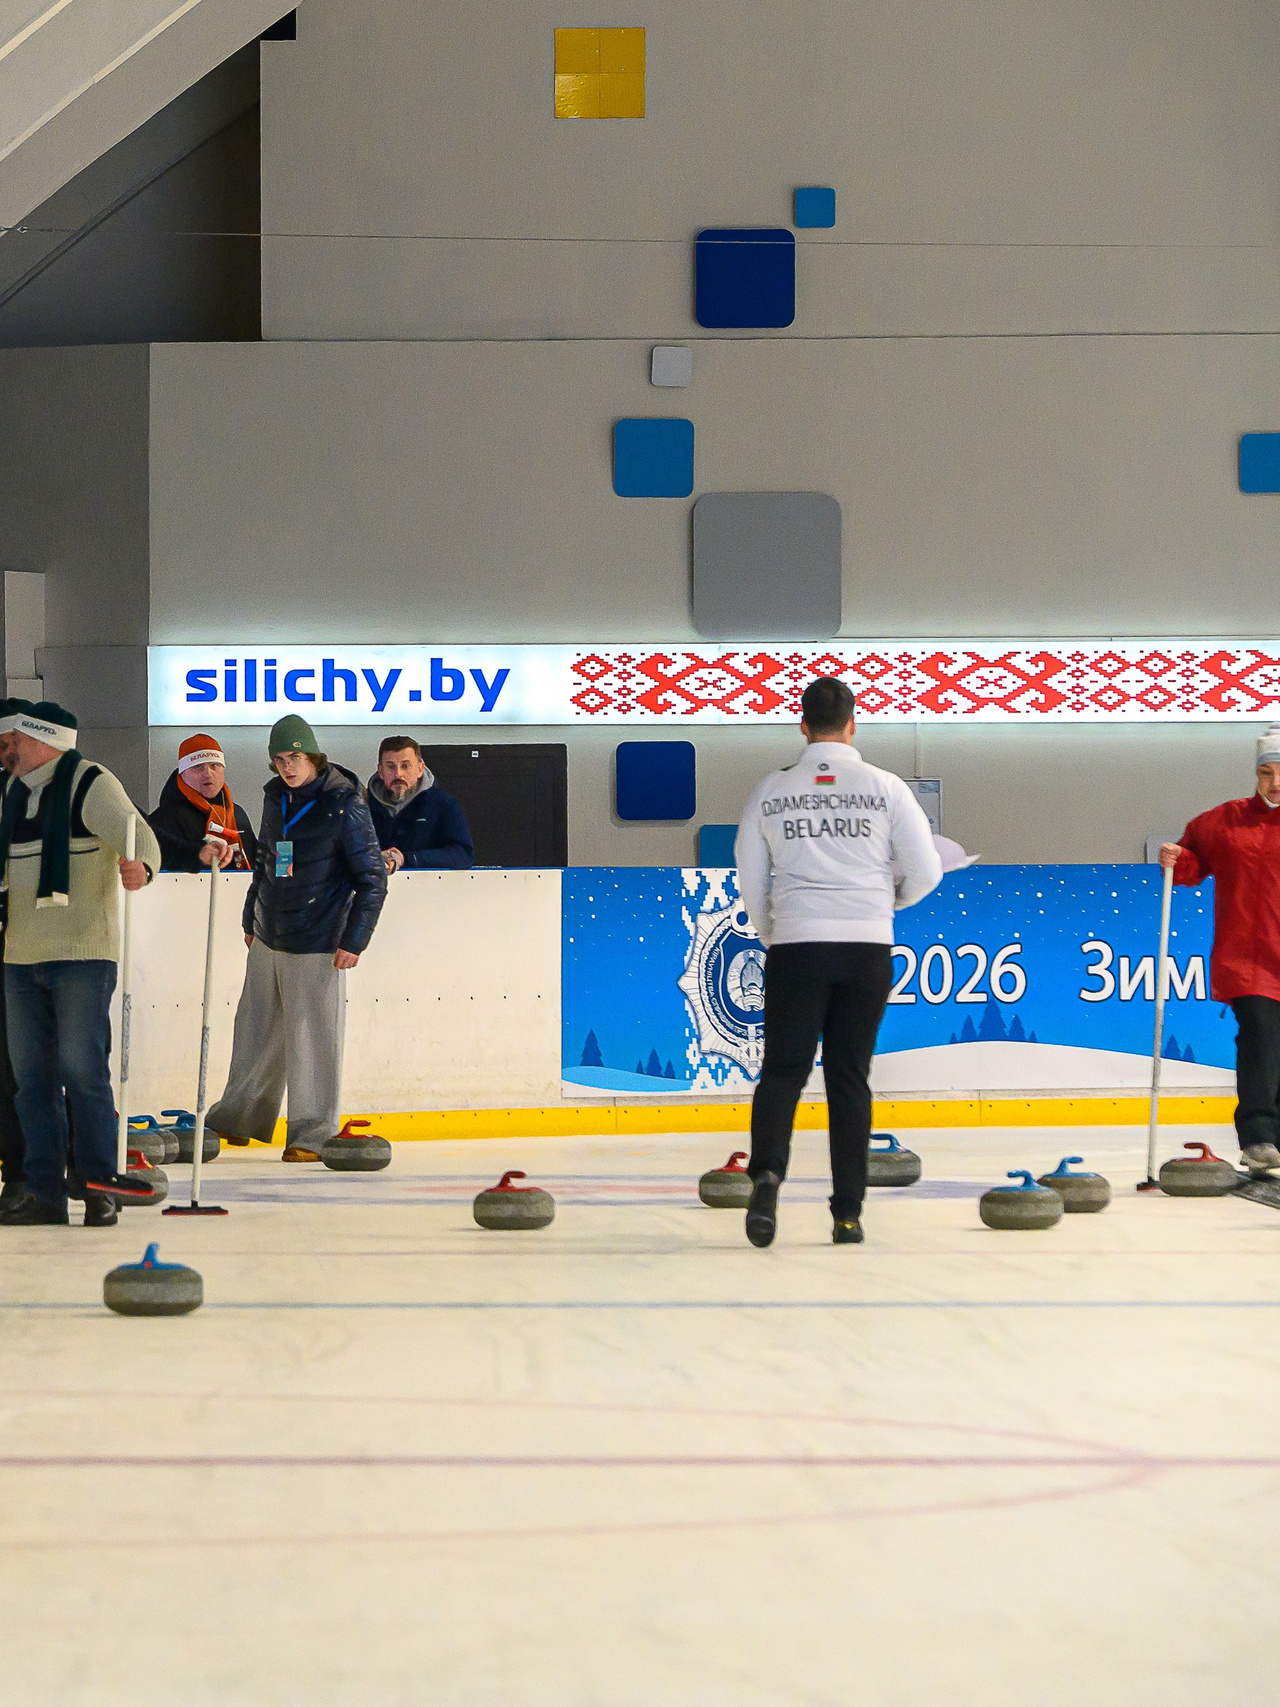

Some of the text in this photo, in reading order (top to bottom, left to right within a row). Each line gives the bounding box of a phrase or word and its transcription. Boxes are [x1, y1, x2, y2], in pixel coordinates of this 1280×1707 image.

[186, 657, 511, 712] silichy.by
[760, 793, 888, 817] DZIAMESHCHANKA
[783, 817, 872, 840] BELARUS
[886, 939, 1208, 1005] 2026 Зим
